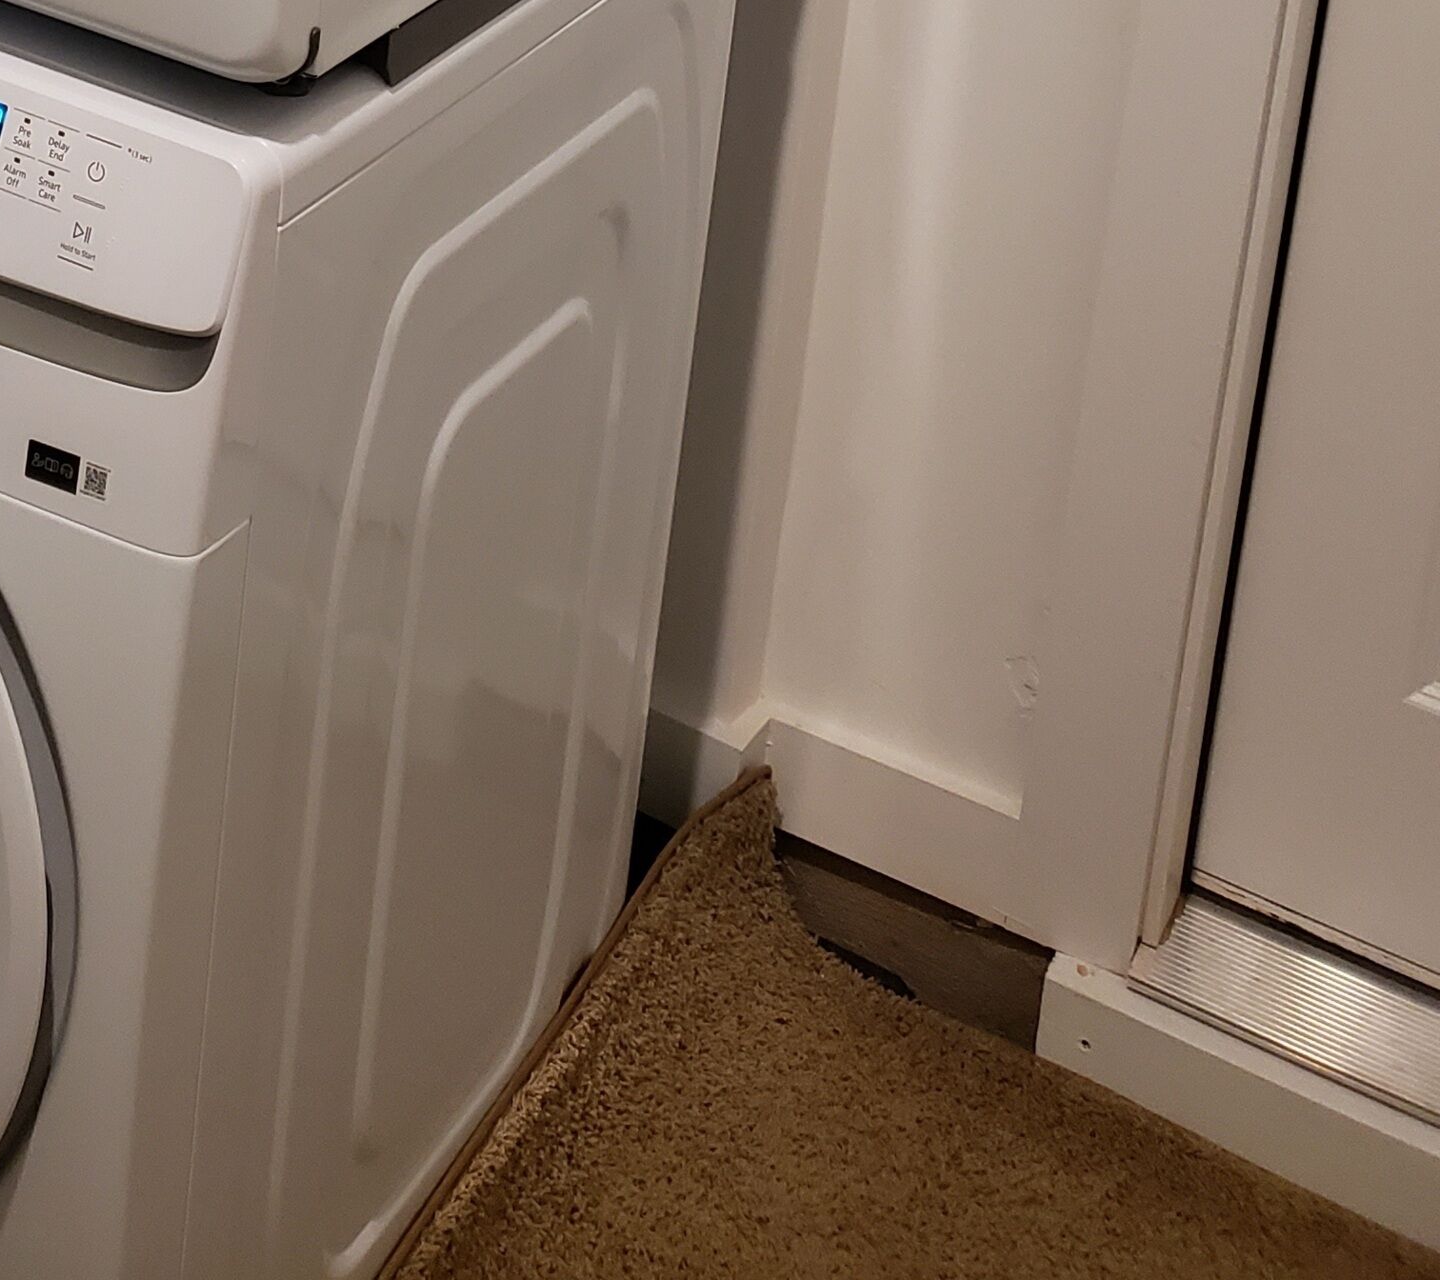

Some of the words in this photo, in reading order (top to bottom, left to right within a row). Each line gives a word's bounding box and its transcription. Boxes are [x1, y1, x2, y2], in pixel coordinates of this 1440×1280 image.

[18, 125, 32, 138] Pre
[12, 136, 32, 150] Soak
[48, 136, 70, 153] Delay
[49, 149, 65, 162] End
[3, 164, 27, 179] Alarm
[6, 172, 21, 188] Off
[38, 176, 62, 192] Smart
[38, 189, 56, 203] Care
[60, 243, 74, 254] Hold
[80, 249, 97, 261] Start
